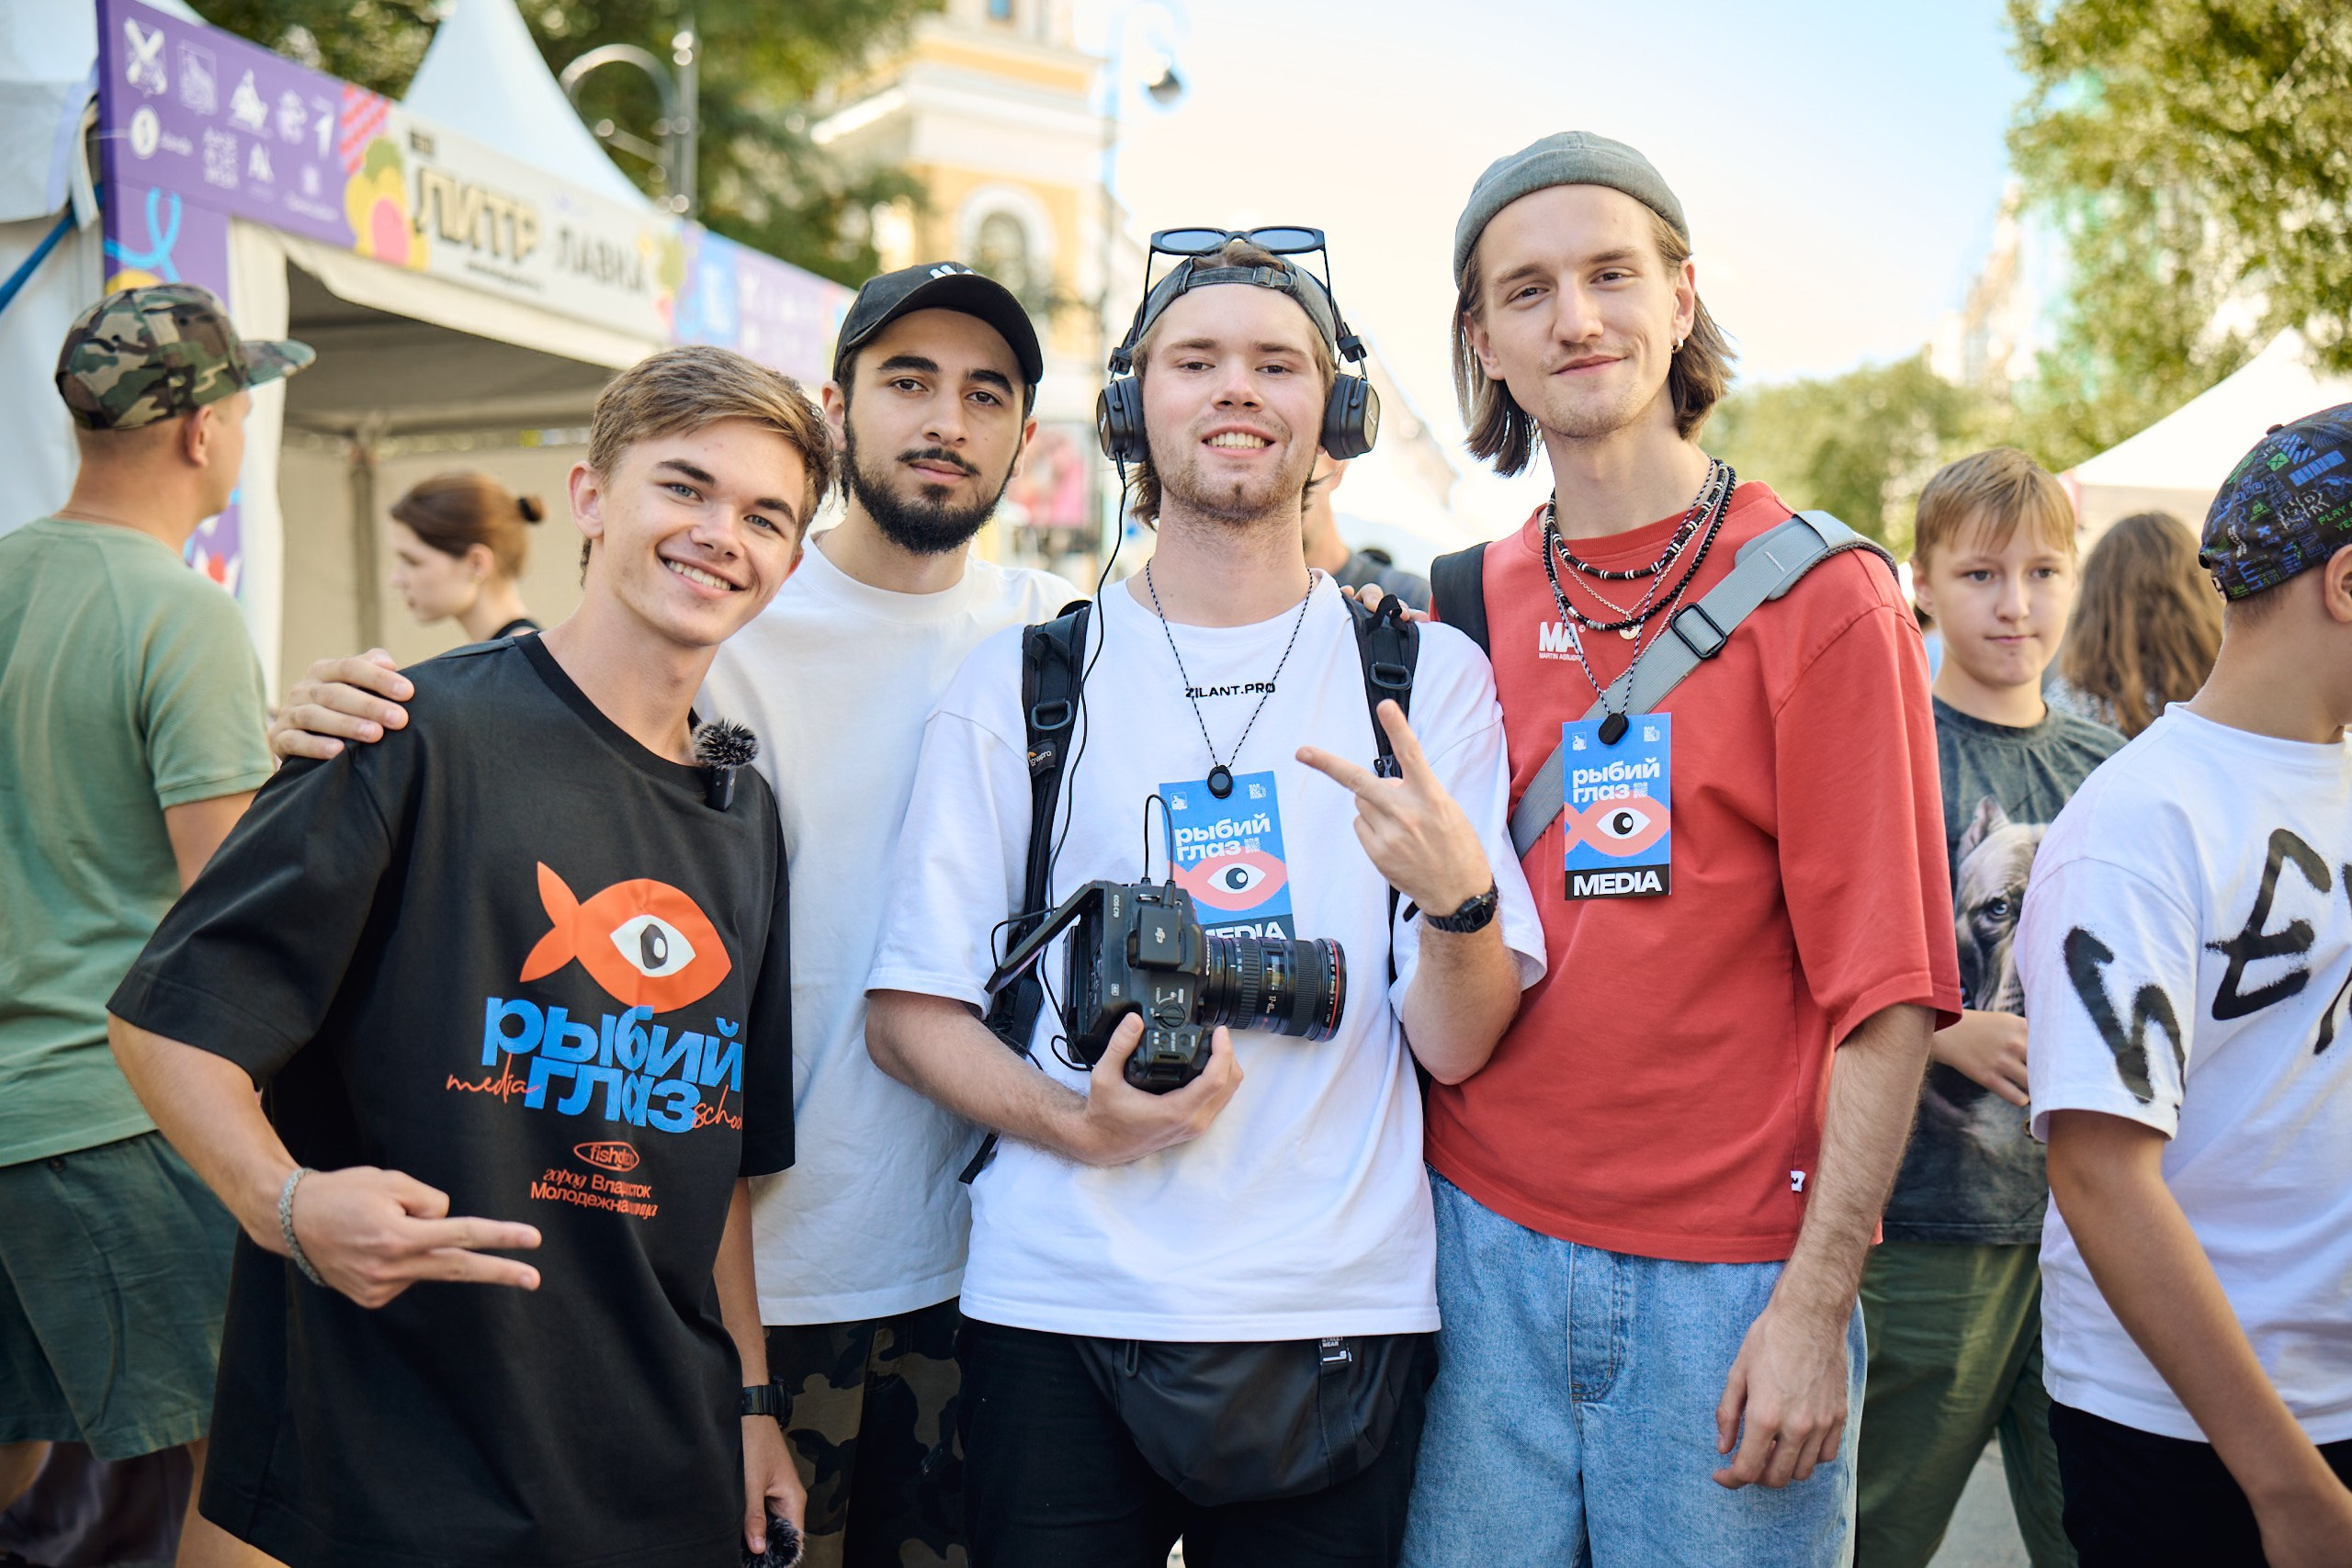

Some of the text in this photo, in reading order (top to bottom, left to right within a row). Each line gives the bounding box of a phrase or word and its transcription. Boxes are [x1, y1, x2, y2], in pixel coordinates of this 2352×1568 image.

[1185, 682, 1276, 698] ZILANT.PRO
[1572, 757, 1660, 789] рыбий
[1572, 783, 1630, 804] глаз
[1175, 812, 1272, 847] рыбий
[1176, 840, 1242, 862] глаз
[1573, 870, 1662, 897] MEDIA
[1204, 921, 1287, 940] EDIA
[481, 997, 743, 1093] рыбий
[446, 1053, 541, 1104] media
[524, 1055, 701, 1134] глаз
[692, 1084, 743, 1131] schoo
[543, 1168, 588, 1190] город
